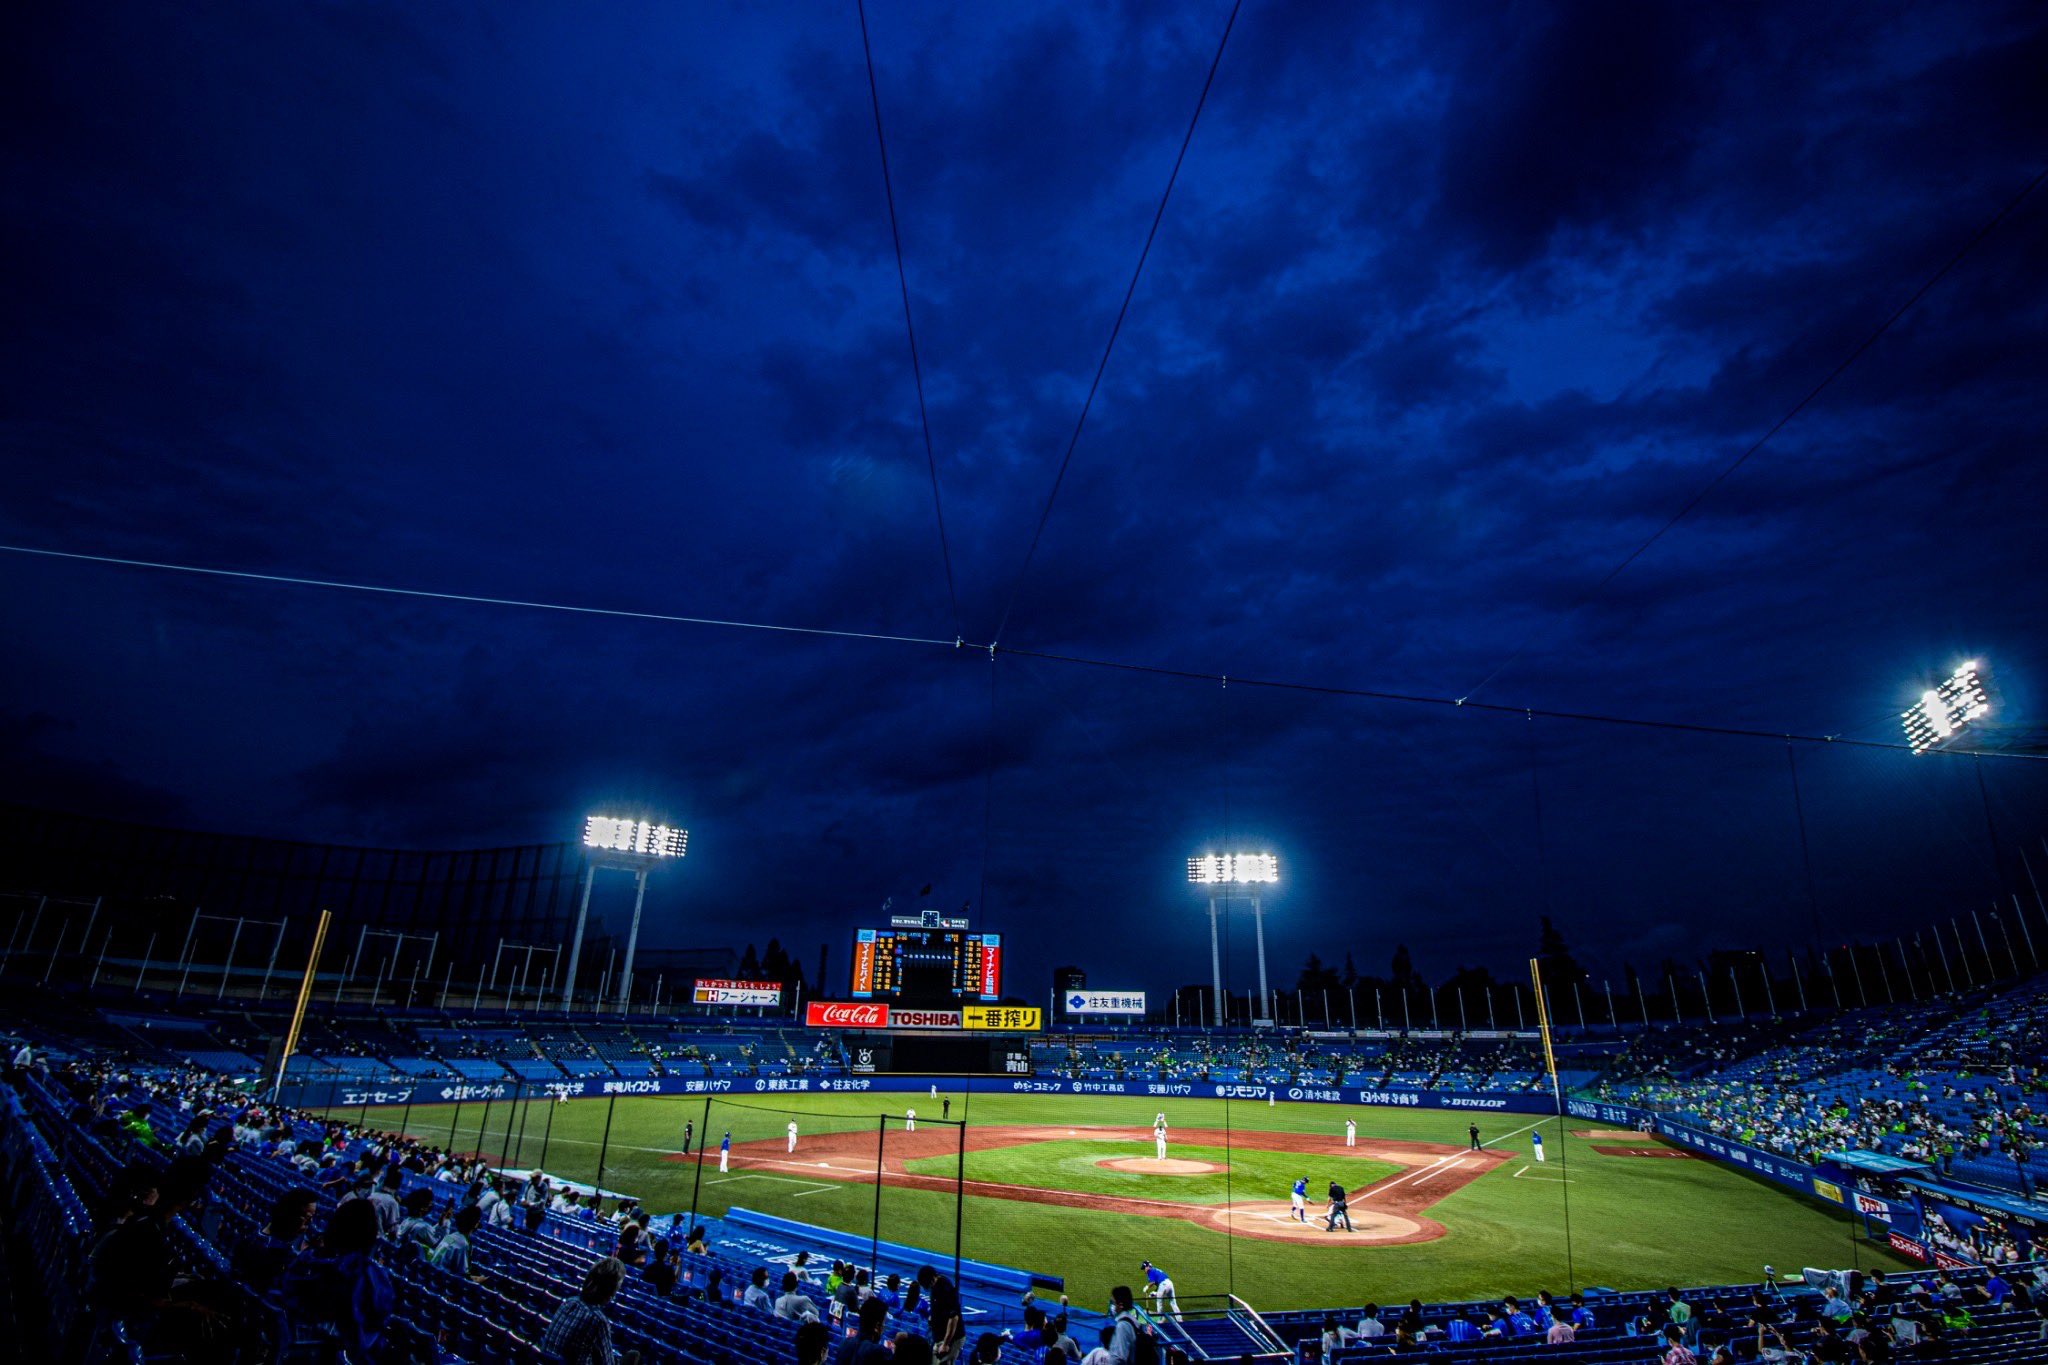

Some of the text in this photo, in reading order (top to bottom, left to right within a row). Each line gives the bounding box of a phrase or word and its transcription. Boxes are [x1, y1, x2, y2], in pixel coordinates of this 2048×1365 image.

[720, 990, 778, 1004] フージャース
[1088, 997, 1143, 1009] 住友重機械
[890, 1012, 960, 1027] TOSHIBA
[967, 1009, 1036, 1028] 一番搾り
[1005, 1060, 1028, 1073] 青山
[685, 1080, 731, 1092] 安藤ハザマ
[767, 1079, 809, 1091] 東鉄工業
[832, 1079, 871, 1090] 住友化学
[1084, 1083, 1125, 1093] 竹中工務店
[1148, 1083, 1191, 1095] 安藤ハザマ
[1225, 1085, 1267, 1098] シモジマ
[1304, 1090, 1341, 1101] 清水建設
[1451, 1098, 1506, 1107] DUNLOP
